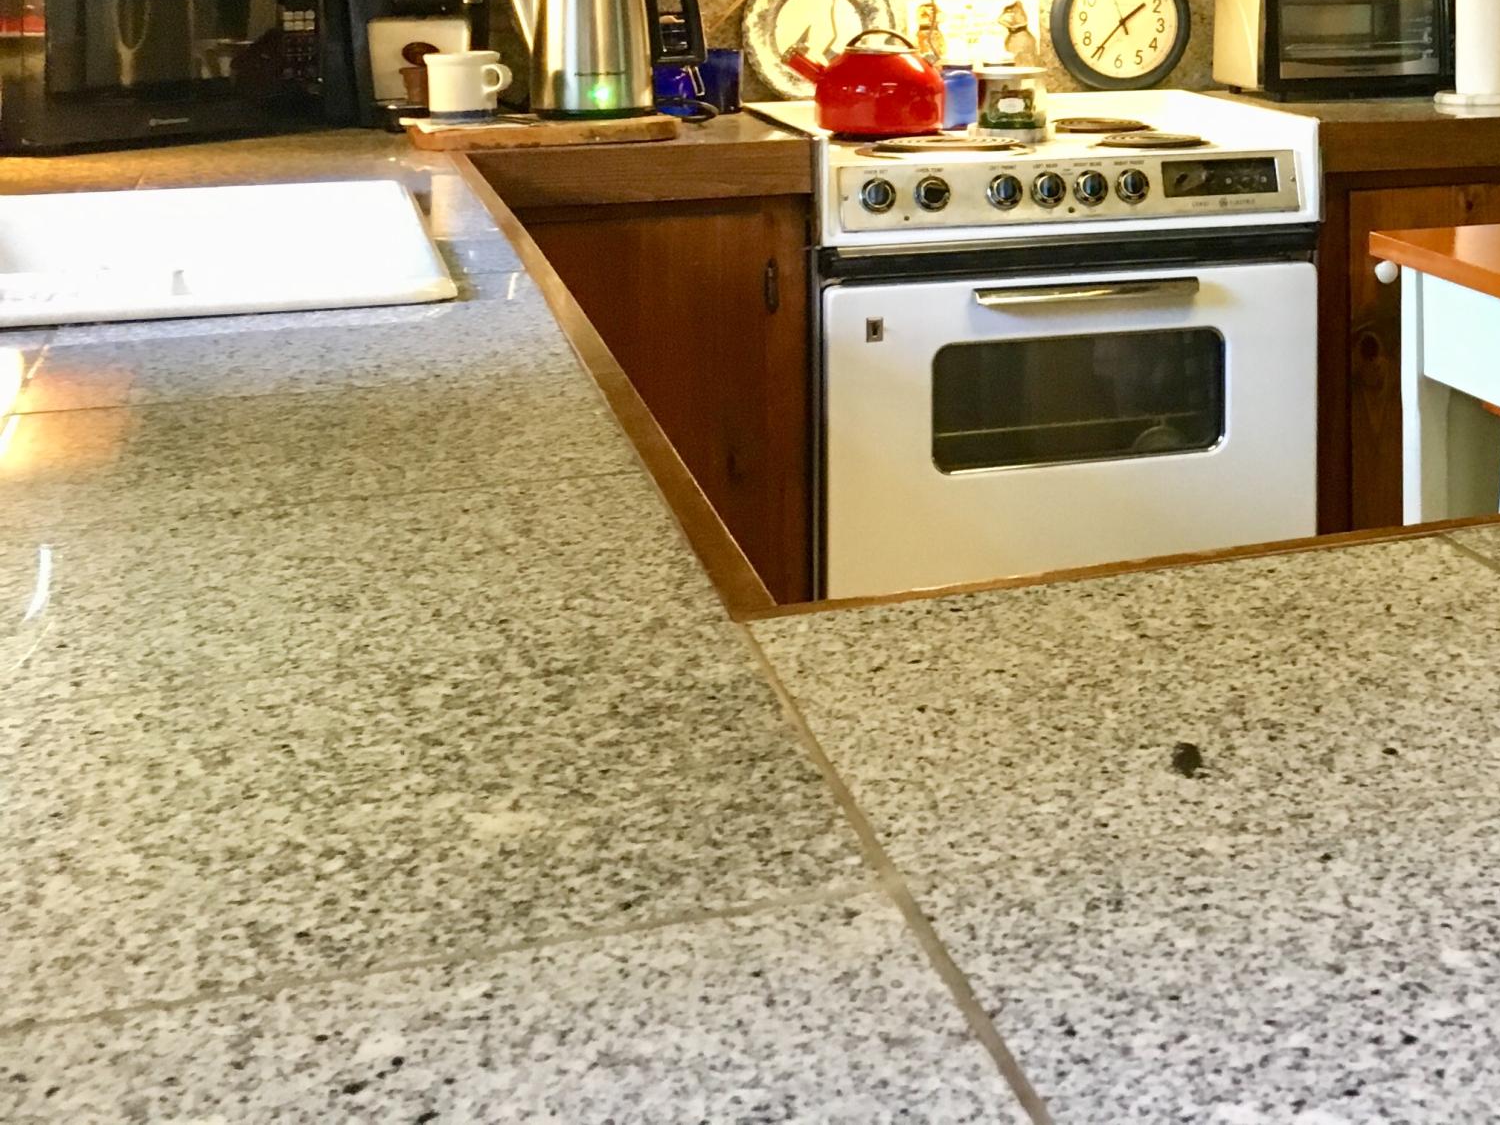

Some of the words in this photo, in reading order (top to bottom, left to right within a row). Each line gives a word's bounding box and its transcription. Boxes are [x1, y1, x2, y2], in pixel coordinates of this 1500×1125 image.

[1079, 11, 1088, 26] 9
[1156, 17, 1165, 33] 3
[1083, 31, 1091, 46] 8
[1148, 37, 1158, 51] 4
[1114, 54, 1122, 69] 6
[1134, 50, 1143, 65] 5
